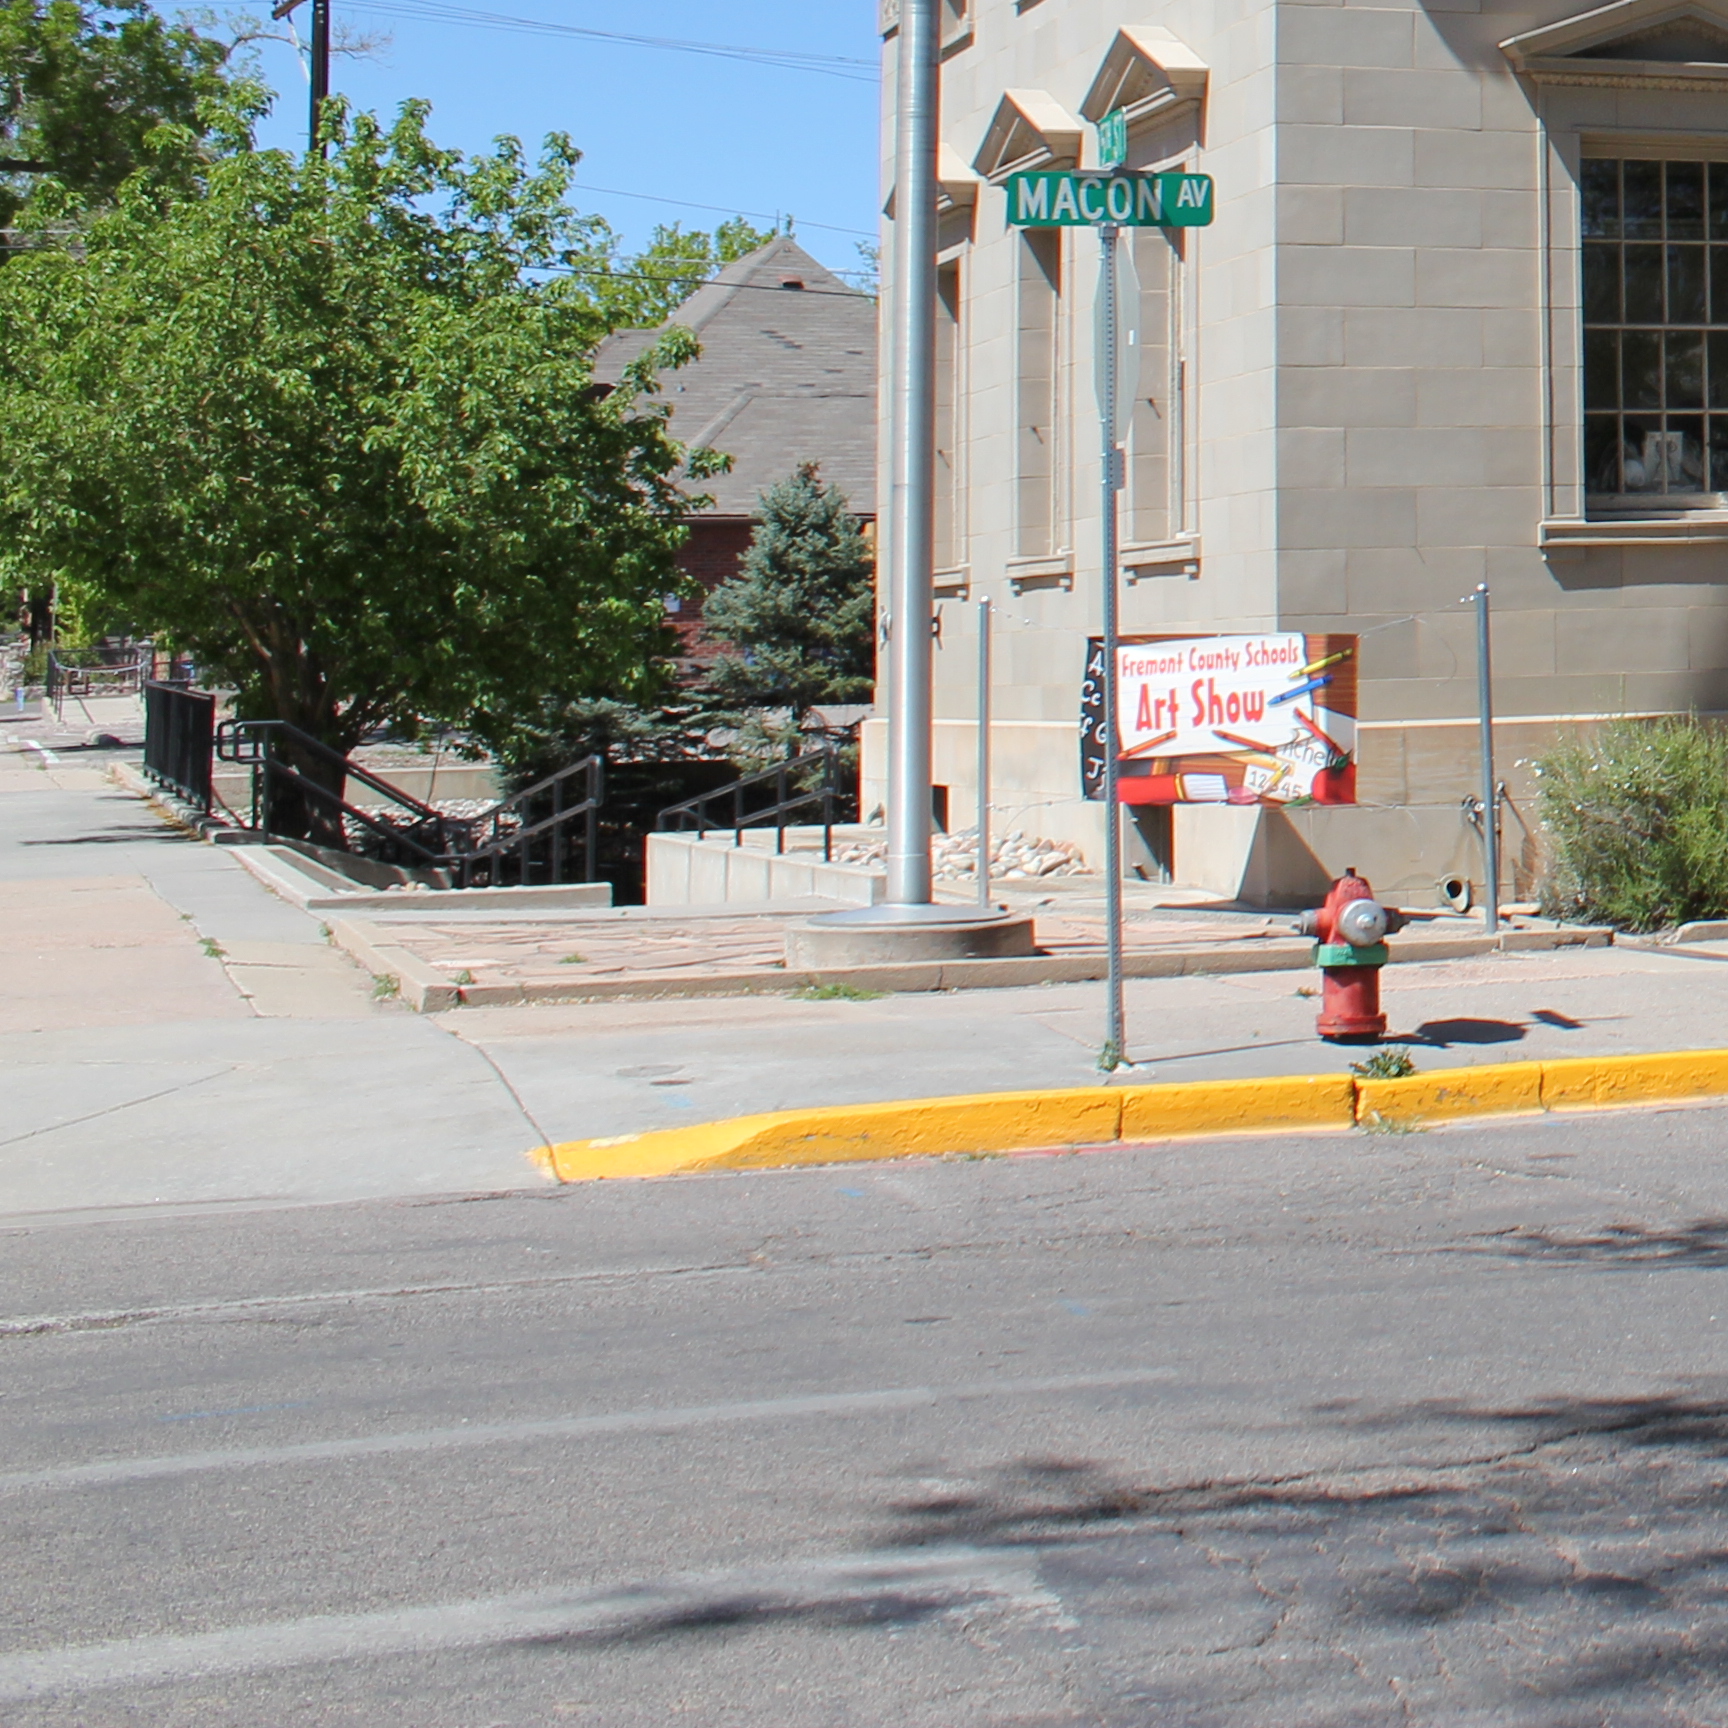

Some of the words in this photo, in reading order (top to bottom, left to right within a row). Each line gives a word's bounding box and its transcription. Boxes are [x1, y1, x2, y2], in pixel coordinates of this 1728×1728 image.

[1017, 176, 1163, 221] MACON
[1176, 178, 1210, 208] AV
[1121, 652, 1184, 679] Fremont
[1188, 645, 1240, 672] County
[1245, 637, 1299, 667] Schools
[1135, 682, 1180, 733] Art
[1190, 676, 1265, 728] Show
